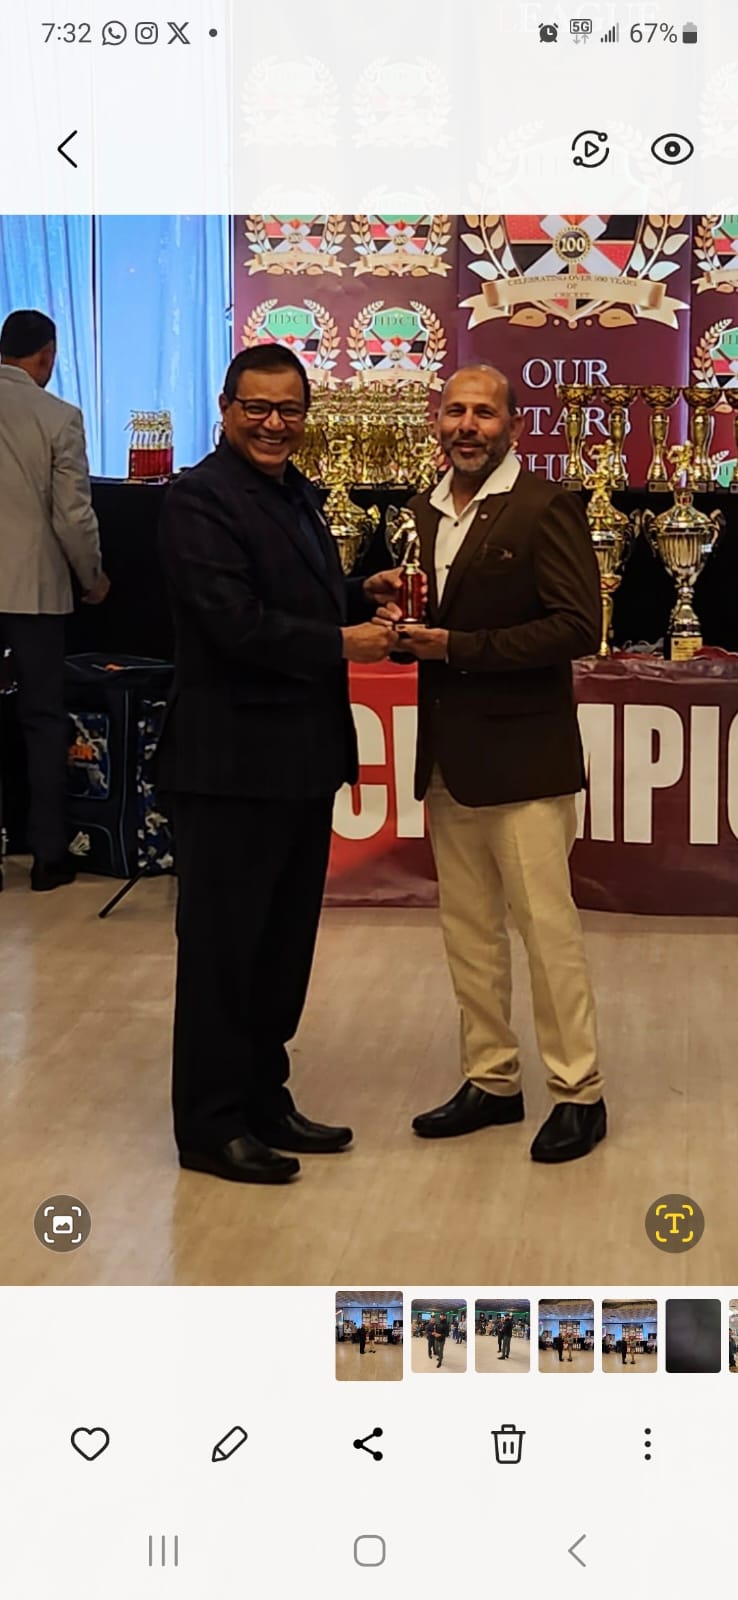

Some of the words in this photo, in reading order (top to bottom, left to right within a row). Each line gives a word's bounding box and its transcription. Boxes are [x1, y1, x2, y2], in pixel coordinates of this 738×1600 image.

[560, 236, 586, 252] 100
[507, 275, 566, 286] CELEBRATING
[610, 276, 637, 287] YEARS
[566, 282, 577, 290] OF
[522, 358, 610, 389] OUR
[516, 406, 631, 436] TAR
